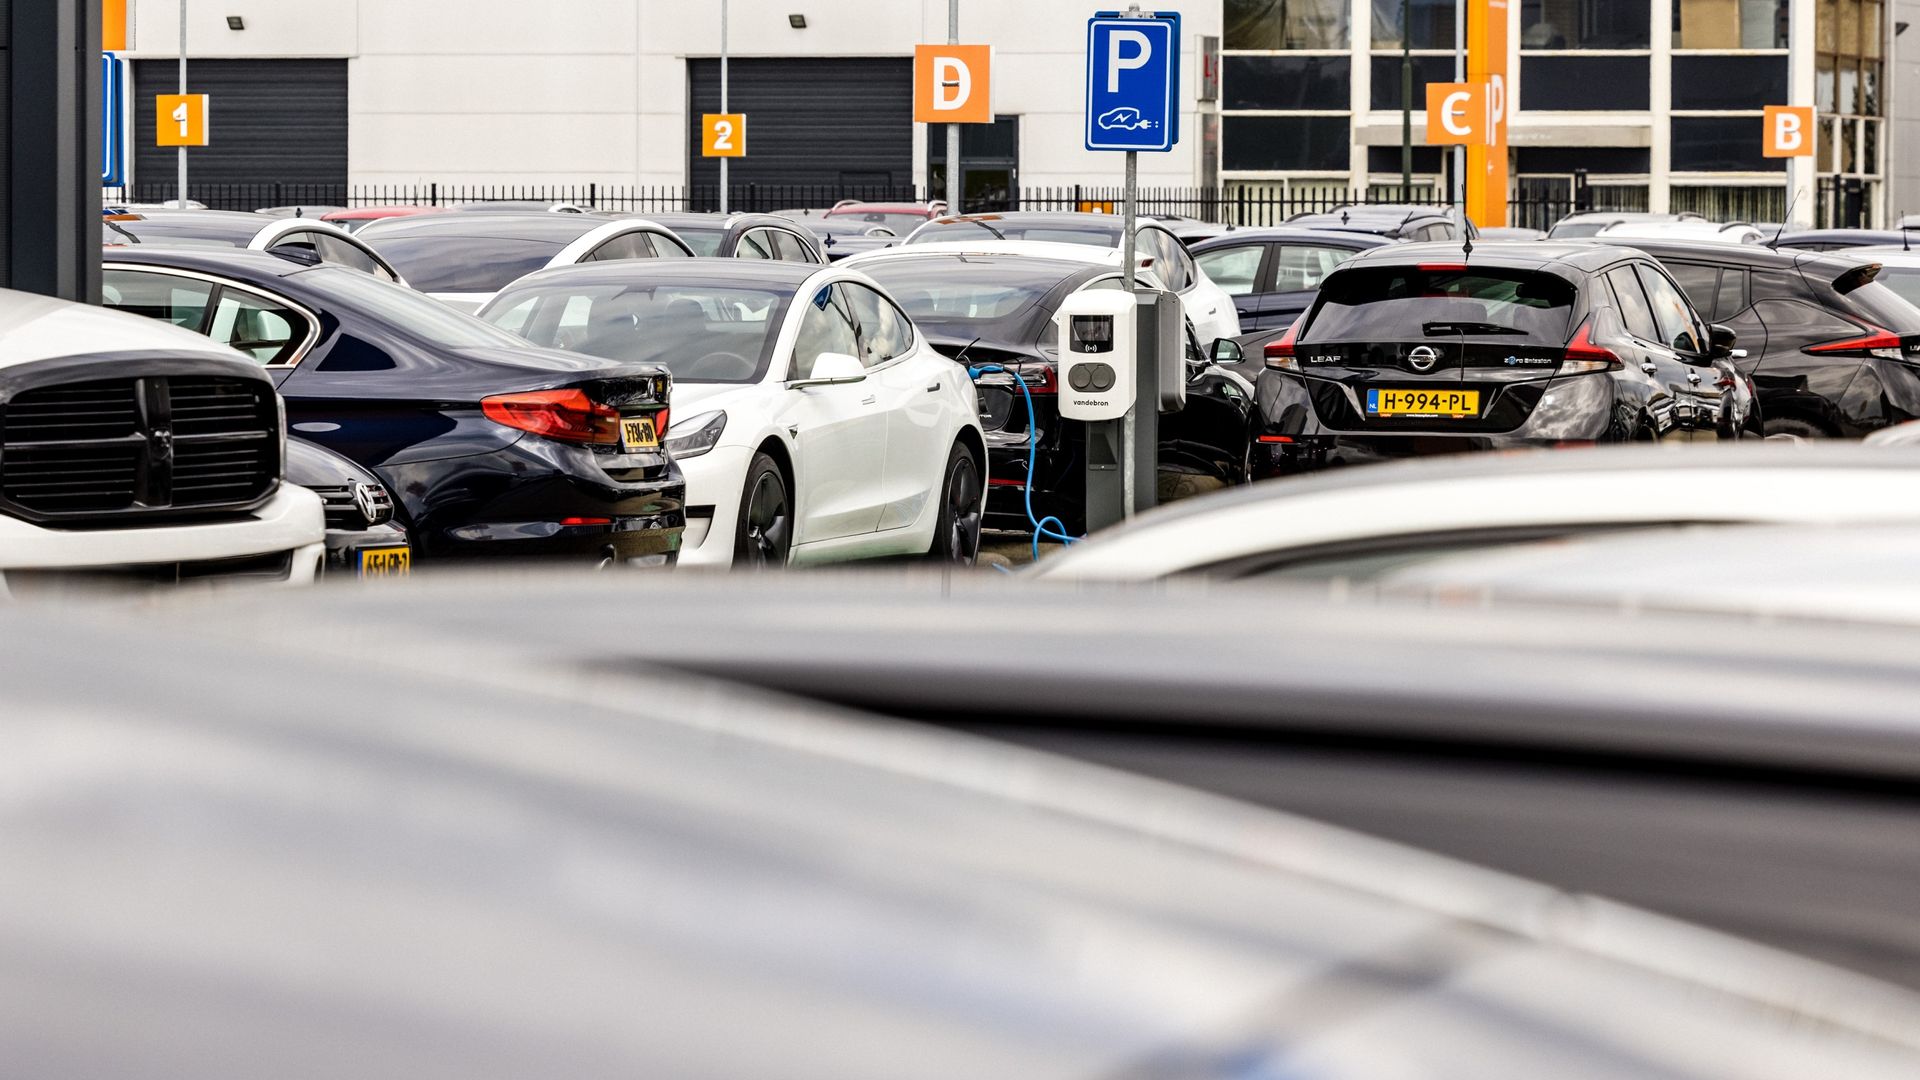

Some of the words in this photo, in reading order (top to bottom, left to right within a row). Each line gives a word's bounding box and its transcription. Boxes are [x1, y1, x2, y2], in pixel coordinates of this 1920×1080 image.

[1107, 30, 1152, 92] P
[933, 56, 971, 110] D
[172, 102, 188, 137] 1
[1441, 91, 1472, 136] C
[1775, 112, 1802, 150] B
[714, 121, 733, 150] 2
[1310, 355, 1341, 363] LEAF
[1384, 393, 1471, 411] H-994-PL
